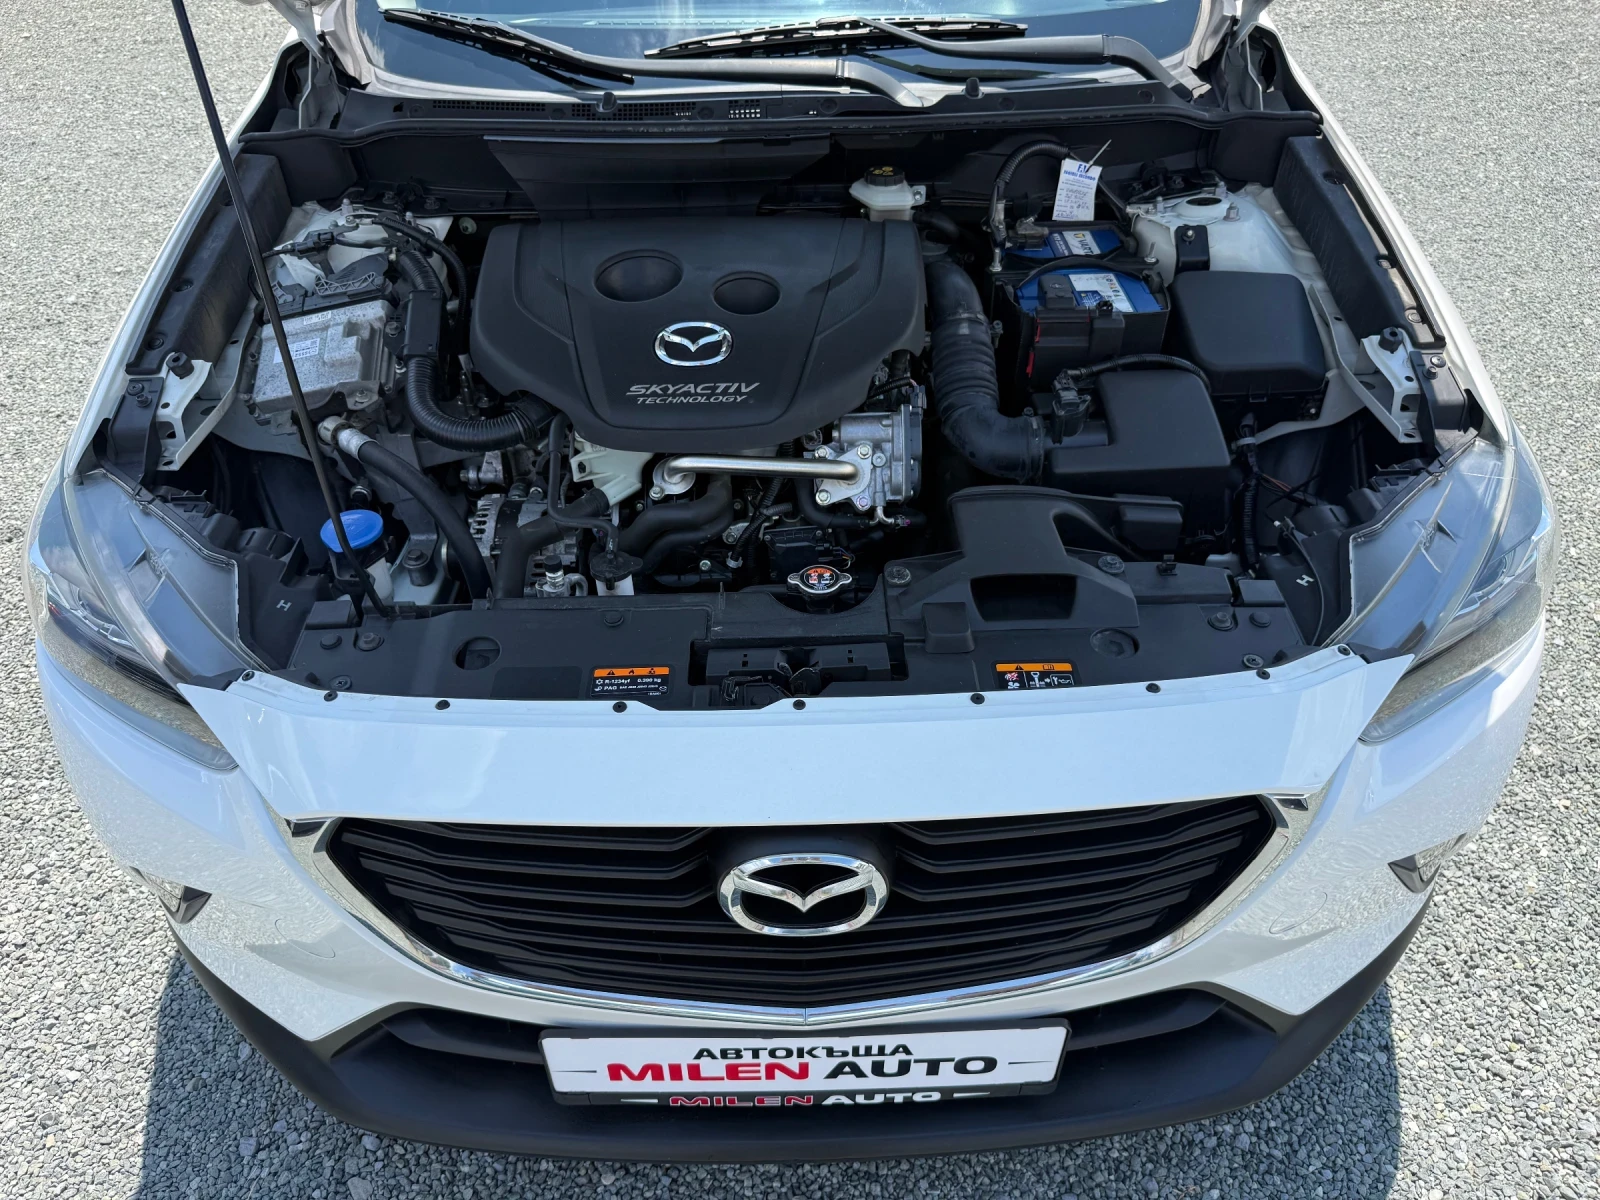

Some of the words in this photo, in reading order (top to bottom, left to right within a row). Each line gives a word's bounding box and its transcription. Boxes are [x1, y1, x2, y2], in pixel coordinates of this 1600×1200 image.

[1077, 238, 1094, 255] VART
[625, 382, 761, 395] SKYACTIV
[636, 395, 748, 405] TECHNOLOGY
[692, 1043, 914, 1060] АВТОКЪША
[606, 1061, 810, 1082] MILEN
[823, 1056, 999, 1080] AUTO
[669, 1095, 814, 1107] MILEN
[821, 1091, 942, 1105] AUTO
